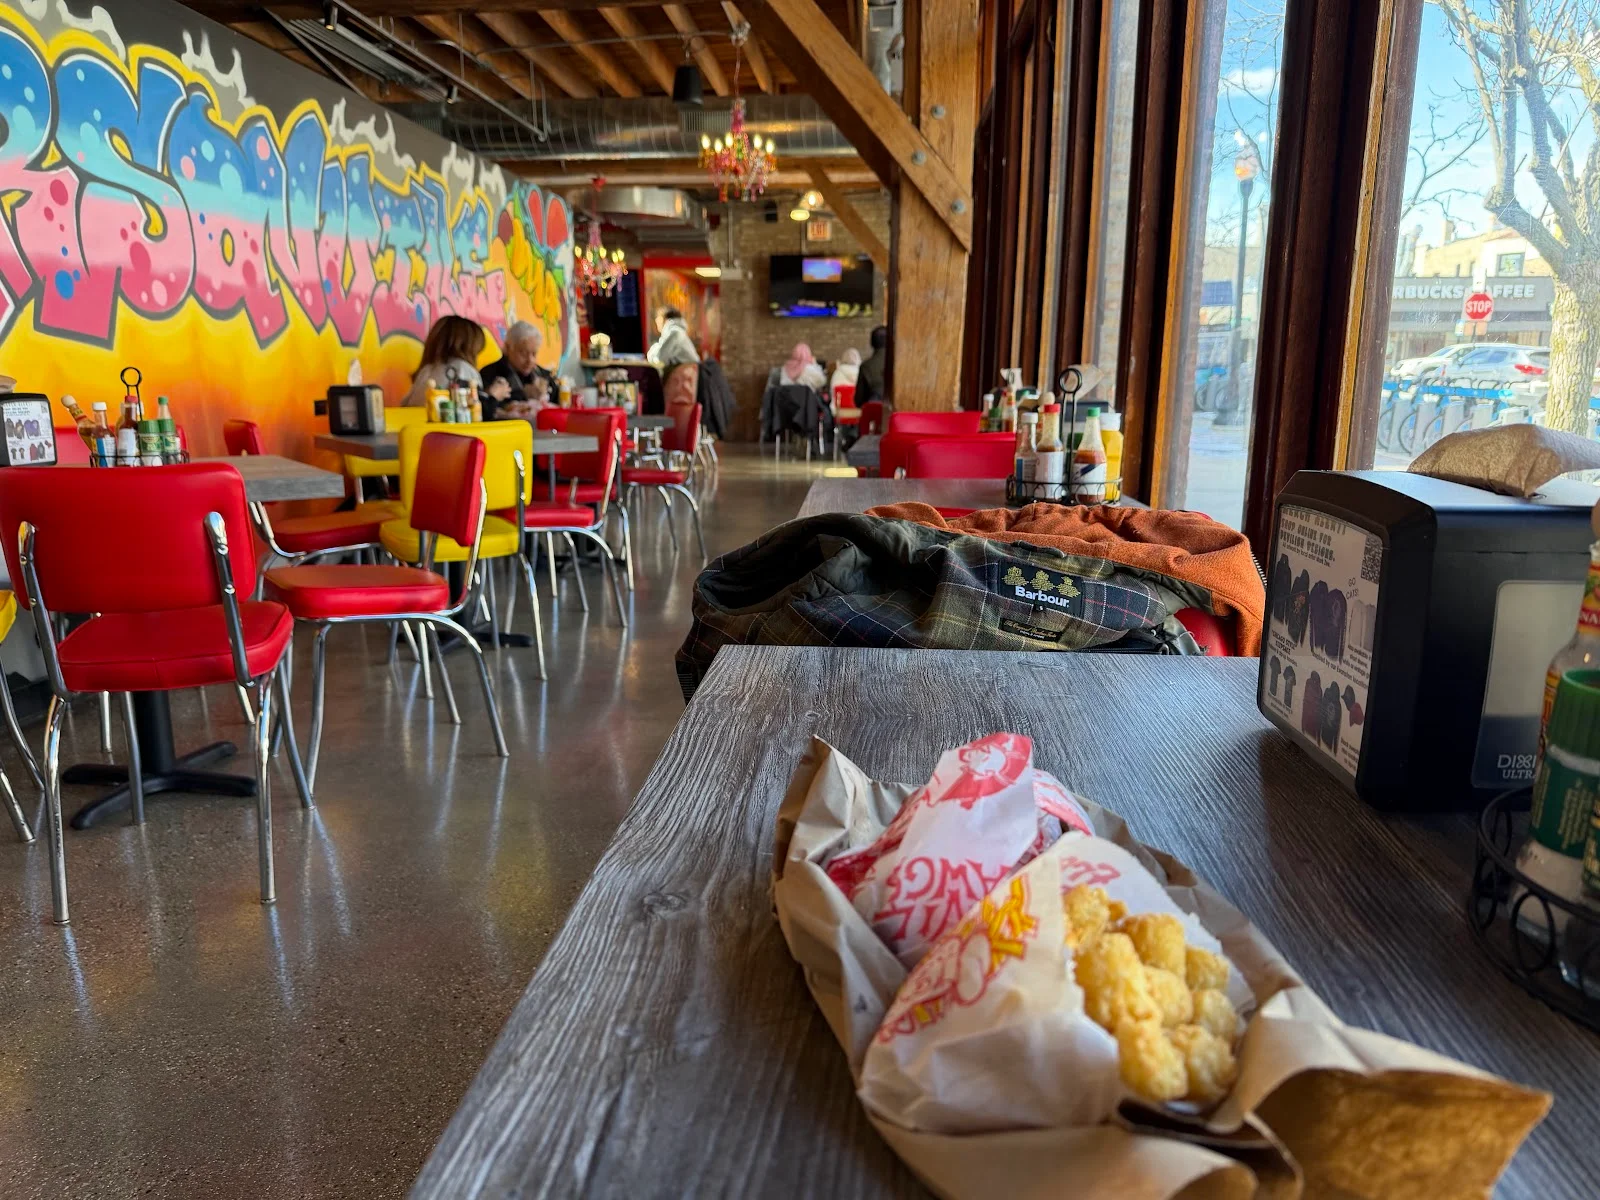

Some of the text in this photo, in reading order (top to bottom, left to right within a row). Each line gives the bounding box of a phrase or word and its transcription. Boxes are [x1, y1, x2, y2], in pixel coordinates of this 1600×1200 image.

[1465, 285, 1535, 298] FFEE
[1466, 301, 1492, 313] STOP
[1319, 532, 1332, 546] FOR
